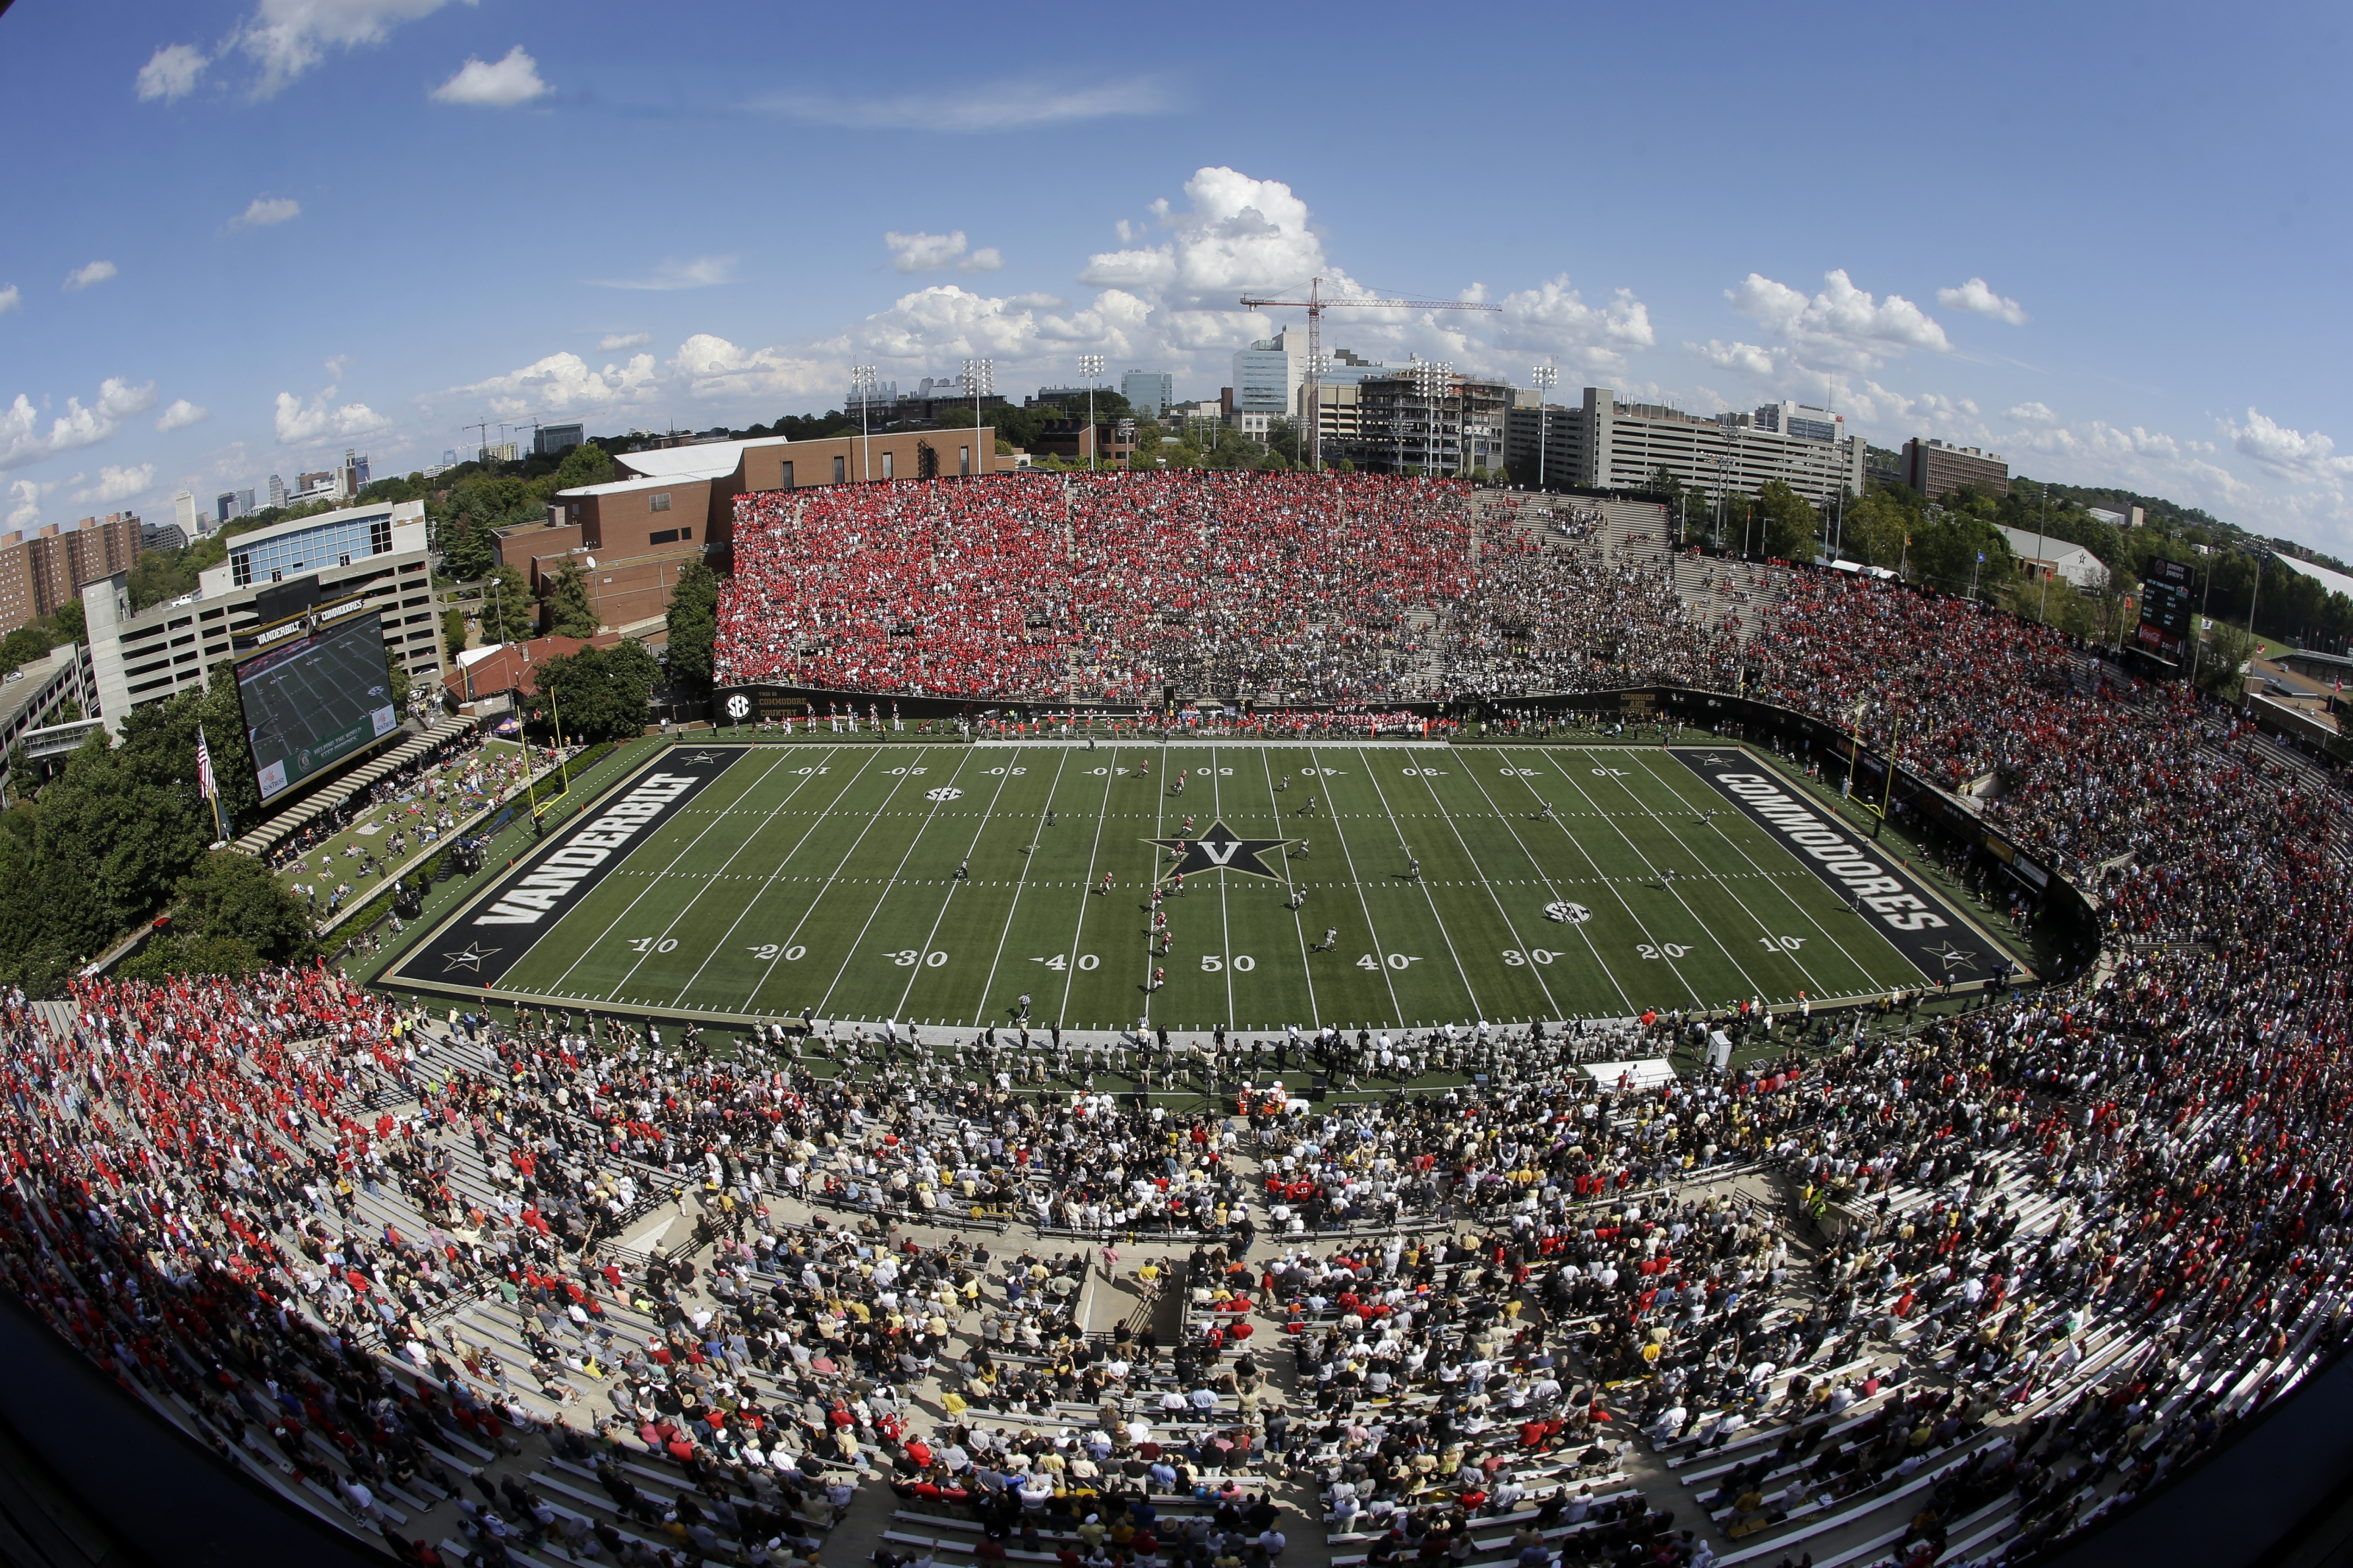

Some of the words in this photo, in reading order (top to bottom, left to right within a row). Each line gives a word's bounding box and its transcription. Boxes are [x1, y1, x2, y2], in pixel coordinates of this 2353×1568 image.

[2165, 569, 2184, 580] JOHN'S
[2166, 562, 2185, 573] JIMMY
[321, 599, 363, 621] COMMODORES
[257, 620, 300, 645] VANDERBILT
[2161, 641, 2177, 653] zero
[727, 695, 749, 718] SEC
[759, 698, 807, 706] COMMODORE
[760, 709, 797, 717] COUNTRY
[926, 787, 963, 801] SEC
[472, 773, 701, 926] VANDERBILT
[1197, 841, 1243, 864] V
[1714, 773, 1950, 931] COMMODORES
[885, 1425, 891, 1435] 11
